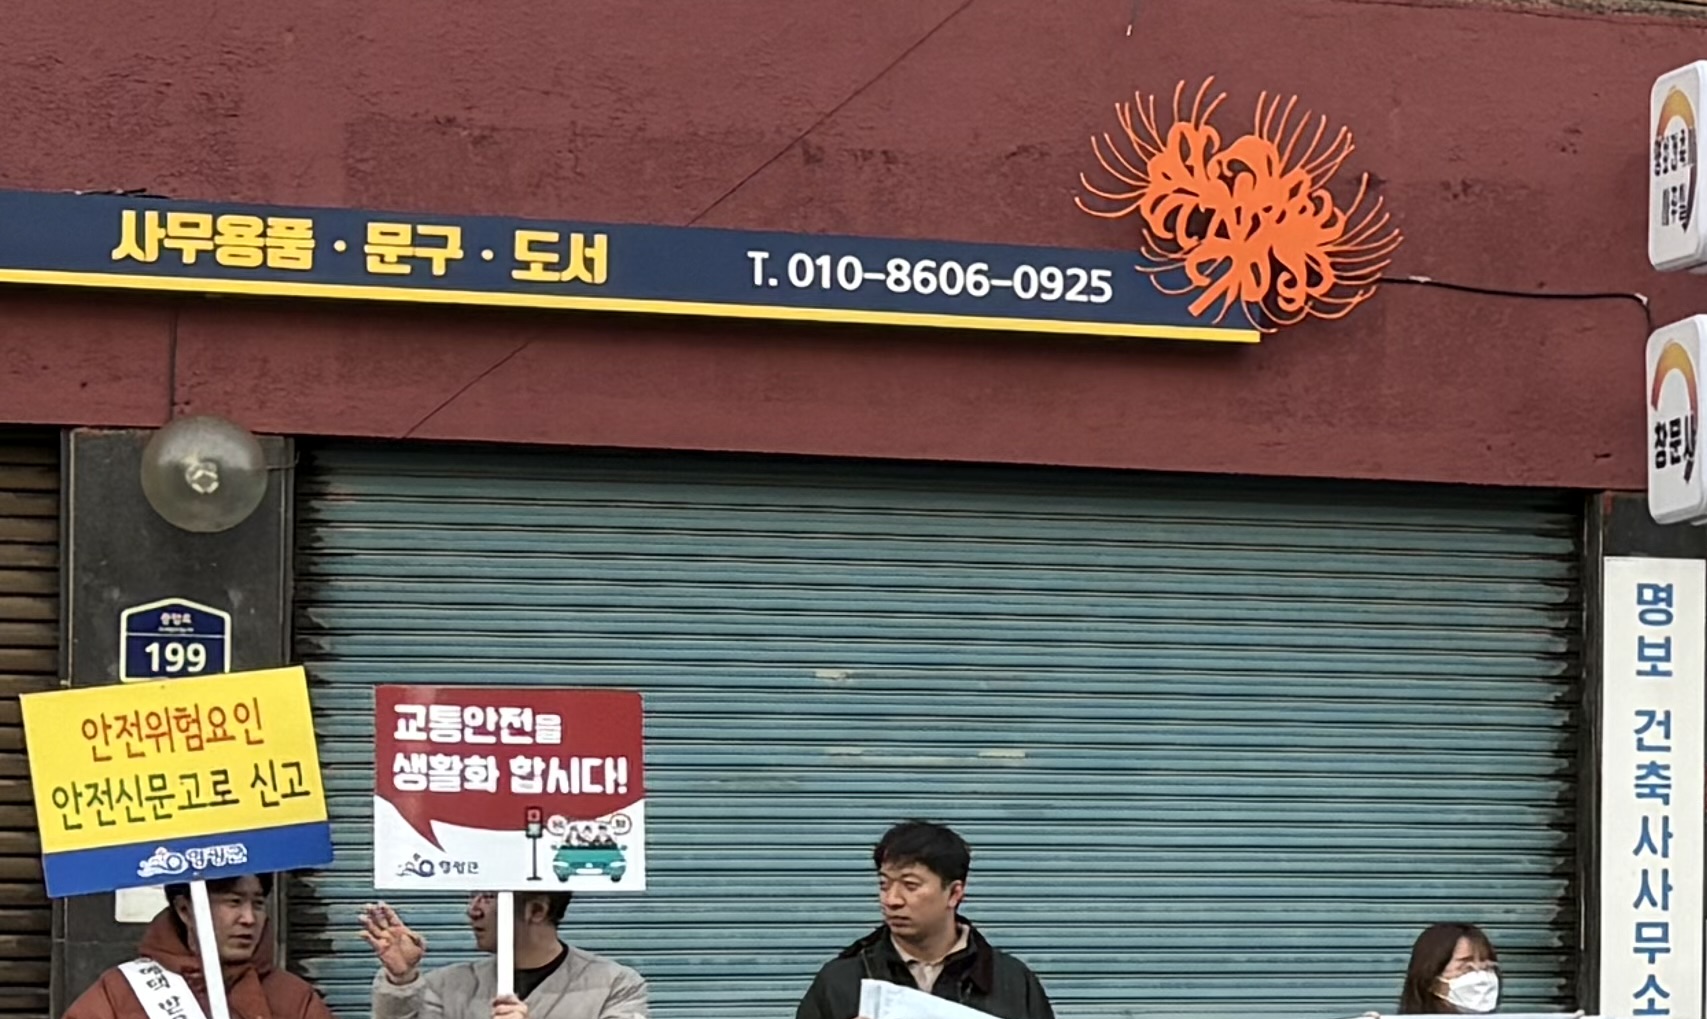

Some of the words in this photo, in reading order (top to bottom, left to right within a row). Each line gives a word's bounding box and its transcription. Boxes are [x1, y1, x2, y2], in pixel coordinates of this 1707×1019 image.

[112, 209, 316, 271] 사무용품
[363, 221, 463, 277] 문구
[511, 229, 609, 284] 도서
[747, 250, 778, 288] T.
[787, 253, 1113, 304] 010-8606-0925
[144, 641, 207, 673] 199
[1635, 581, 1674, 678] 명보
[81, 697, 265, 762] 안전위험요인
[393, 703, 562, 744] 교통안전을
[52, 768, 240, 831] 안전신문고로
[249, 759, 312, 808] 신고
[392, 752, 501, 794] 생활화
[508, 754, 628, 795] 합시다!
[1632, 709, 1674, 1017] 건축사사무소
